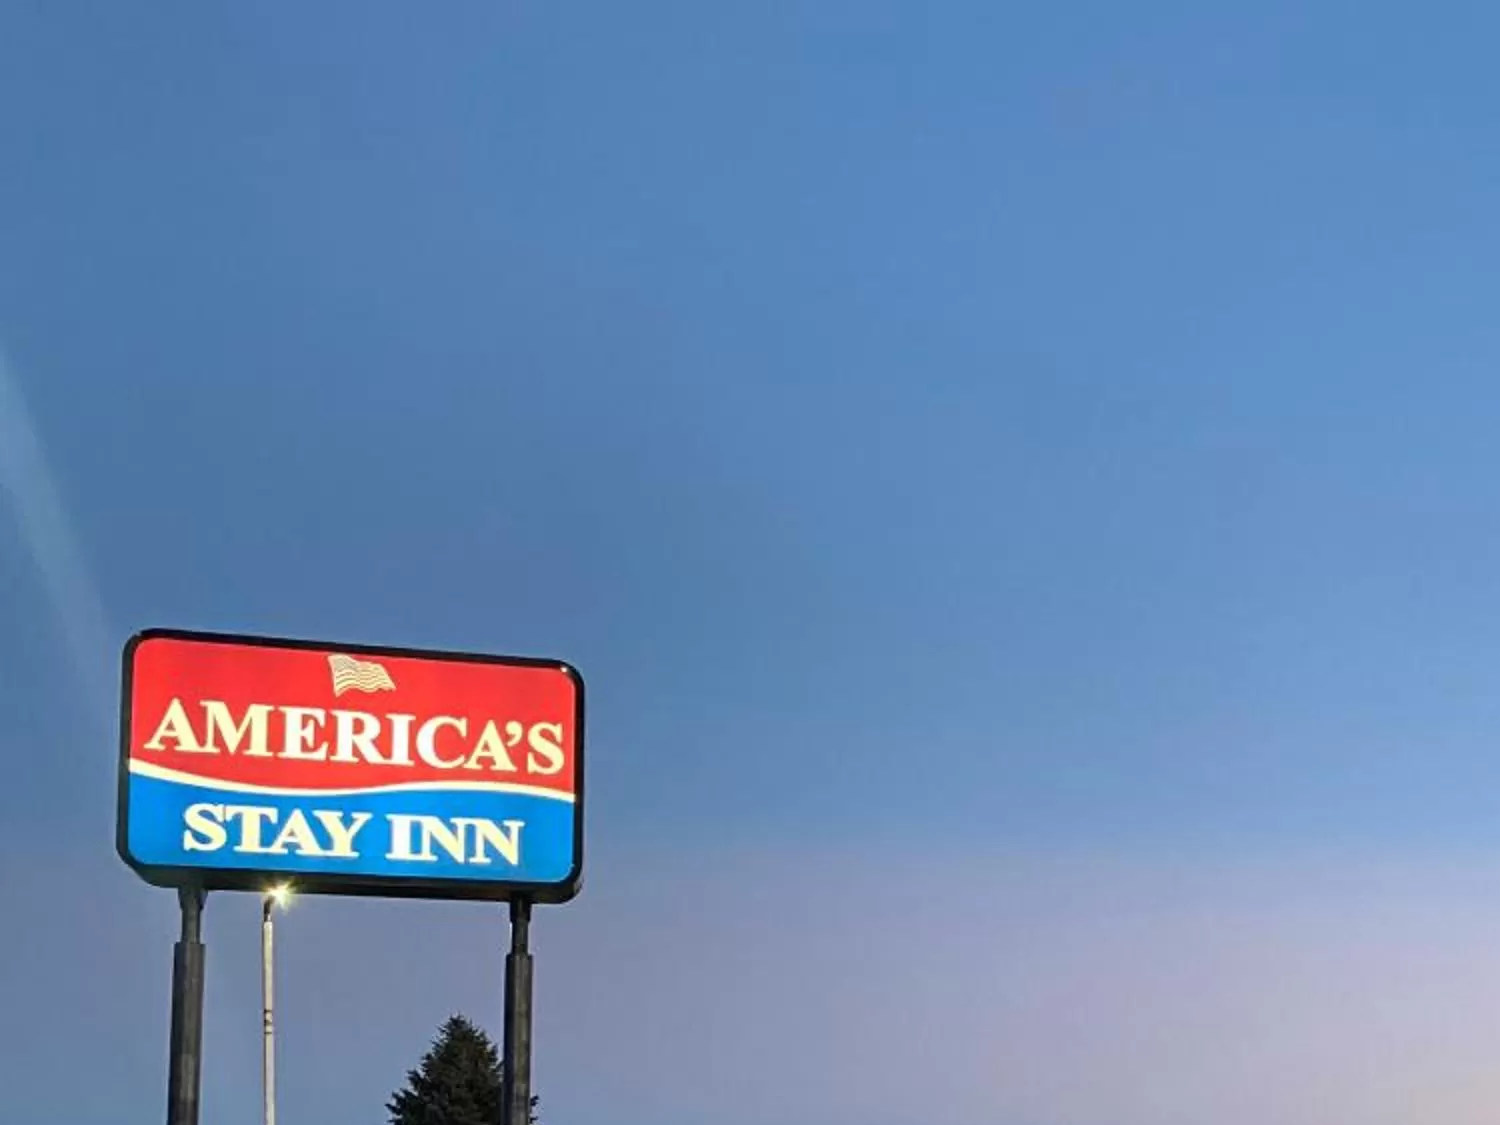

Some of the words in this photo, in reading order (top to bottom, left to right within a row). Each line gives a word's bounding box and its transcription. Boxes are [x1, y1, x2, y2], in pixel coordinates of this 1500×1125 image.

[144, 698, 565, 775] AMERICA'S
[183, 803, 371, 859] STAY
[385, 813, 525, 866] INN
